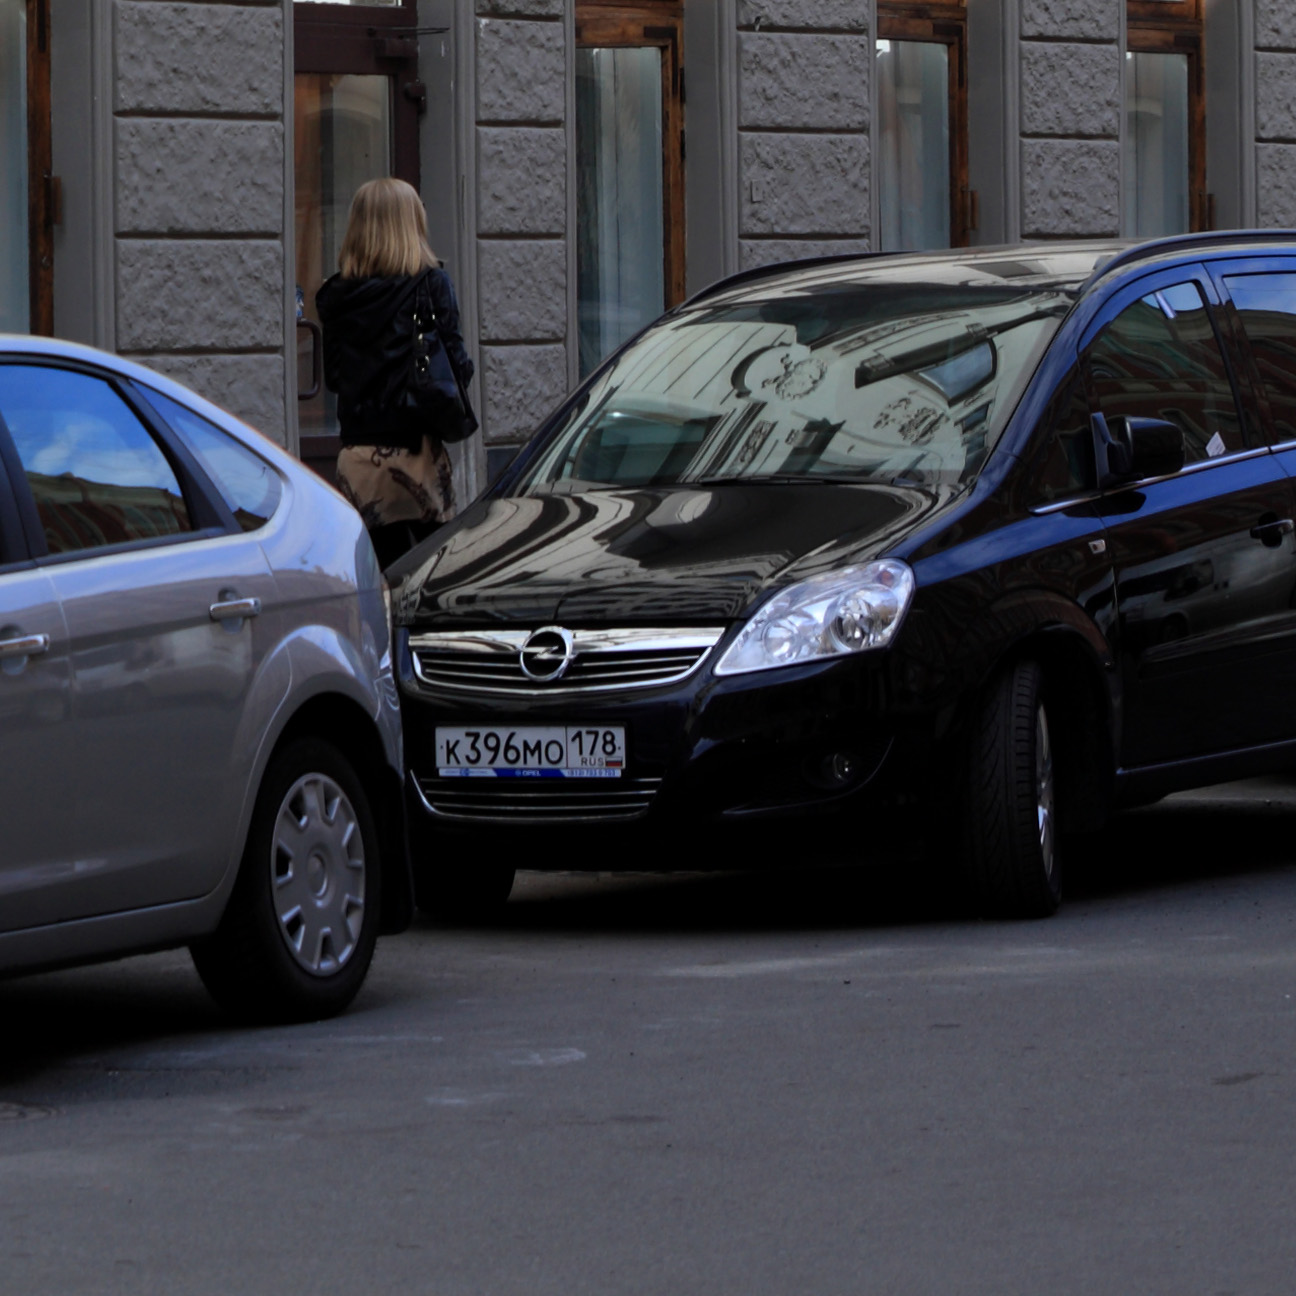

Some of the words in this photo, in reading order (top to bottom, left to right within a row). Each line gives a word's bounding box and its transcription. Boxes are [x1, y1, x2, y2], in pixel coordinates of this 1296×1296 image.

[446, 731, 564, 766] К396МО
[571, 730, 616, 757] 178
[581, 756, 605, 767] RUS
